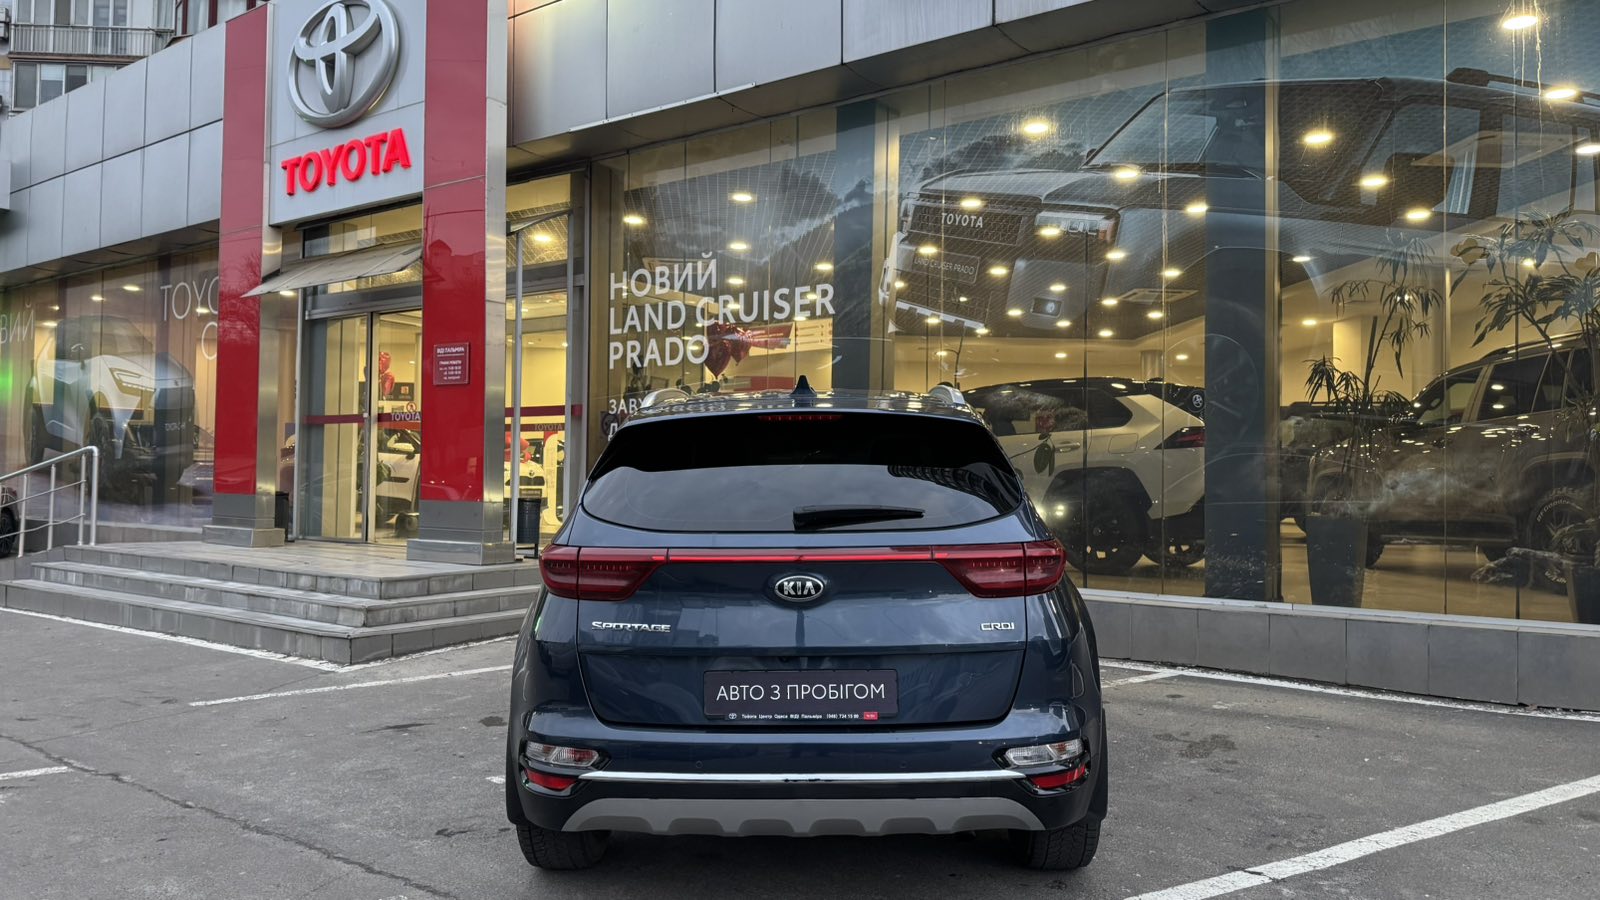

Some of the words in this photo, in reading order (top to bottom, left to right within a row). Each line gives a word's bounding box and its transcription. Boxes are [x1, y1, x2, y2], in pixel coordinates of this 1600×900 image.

[281, 128, 411, 196] TOYOTA
[941, 212, 984, 228] TOYOTA
[610, 251, 717, 300] НОВИЙ
[953, 263, 975, 275] PRADO
[609, 300, 686, 335] LAND
[695, 283, 836, 326] CRUISER
[609, 334, 709, 370] PRADO
[391, 411, 421, 421] TOYOTA
[534, 423, 563, 432] TOYOTA
[783, 580, 816, 596] KIA
[591, 621, 671, 633] SPORTAGE
[716, 685, 764, 701] АВТО
[787, 683, 886, 700] ПРОБІГОМ
